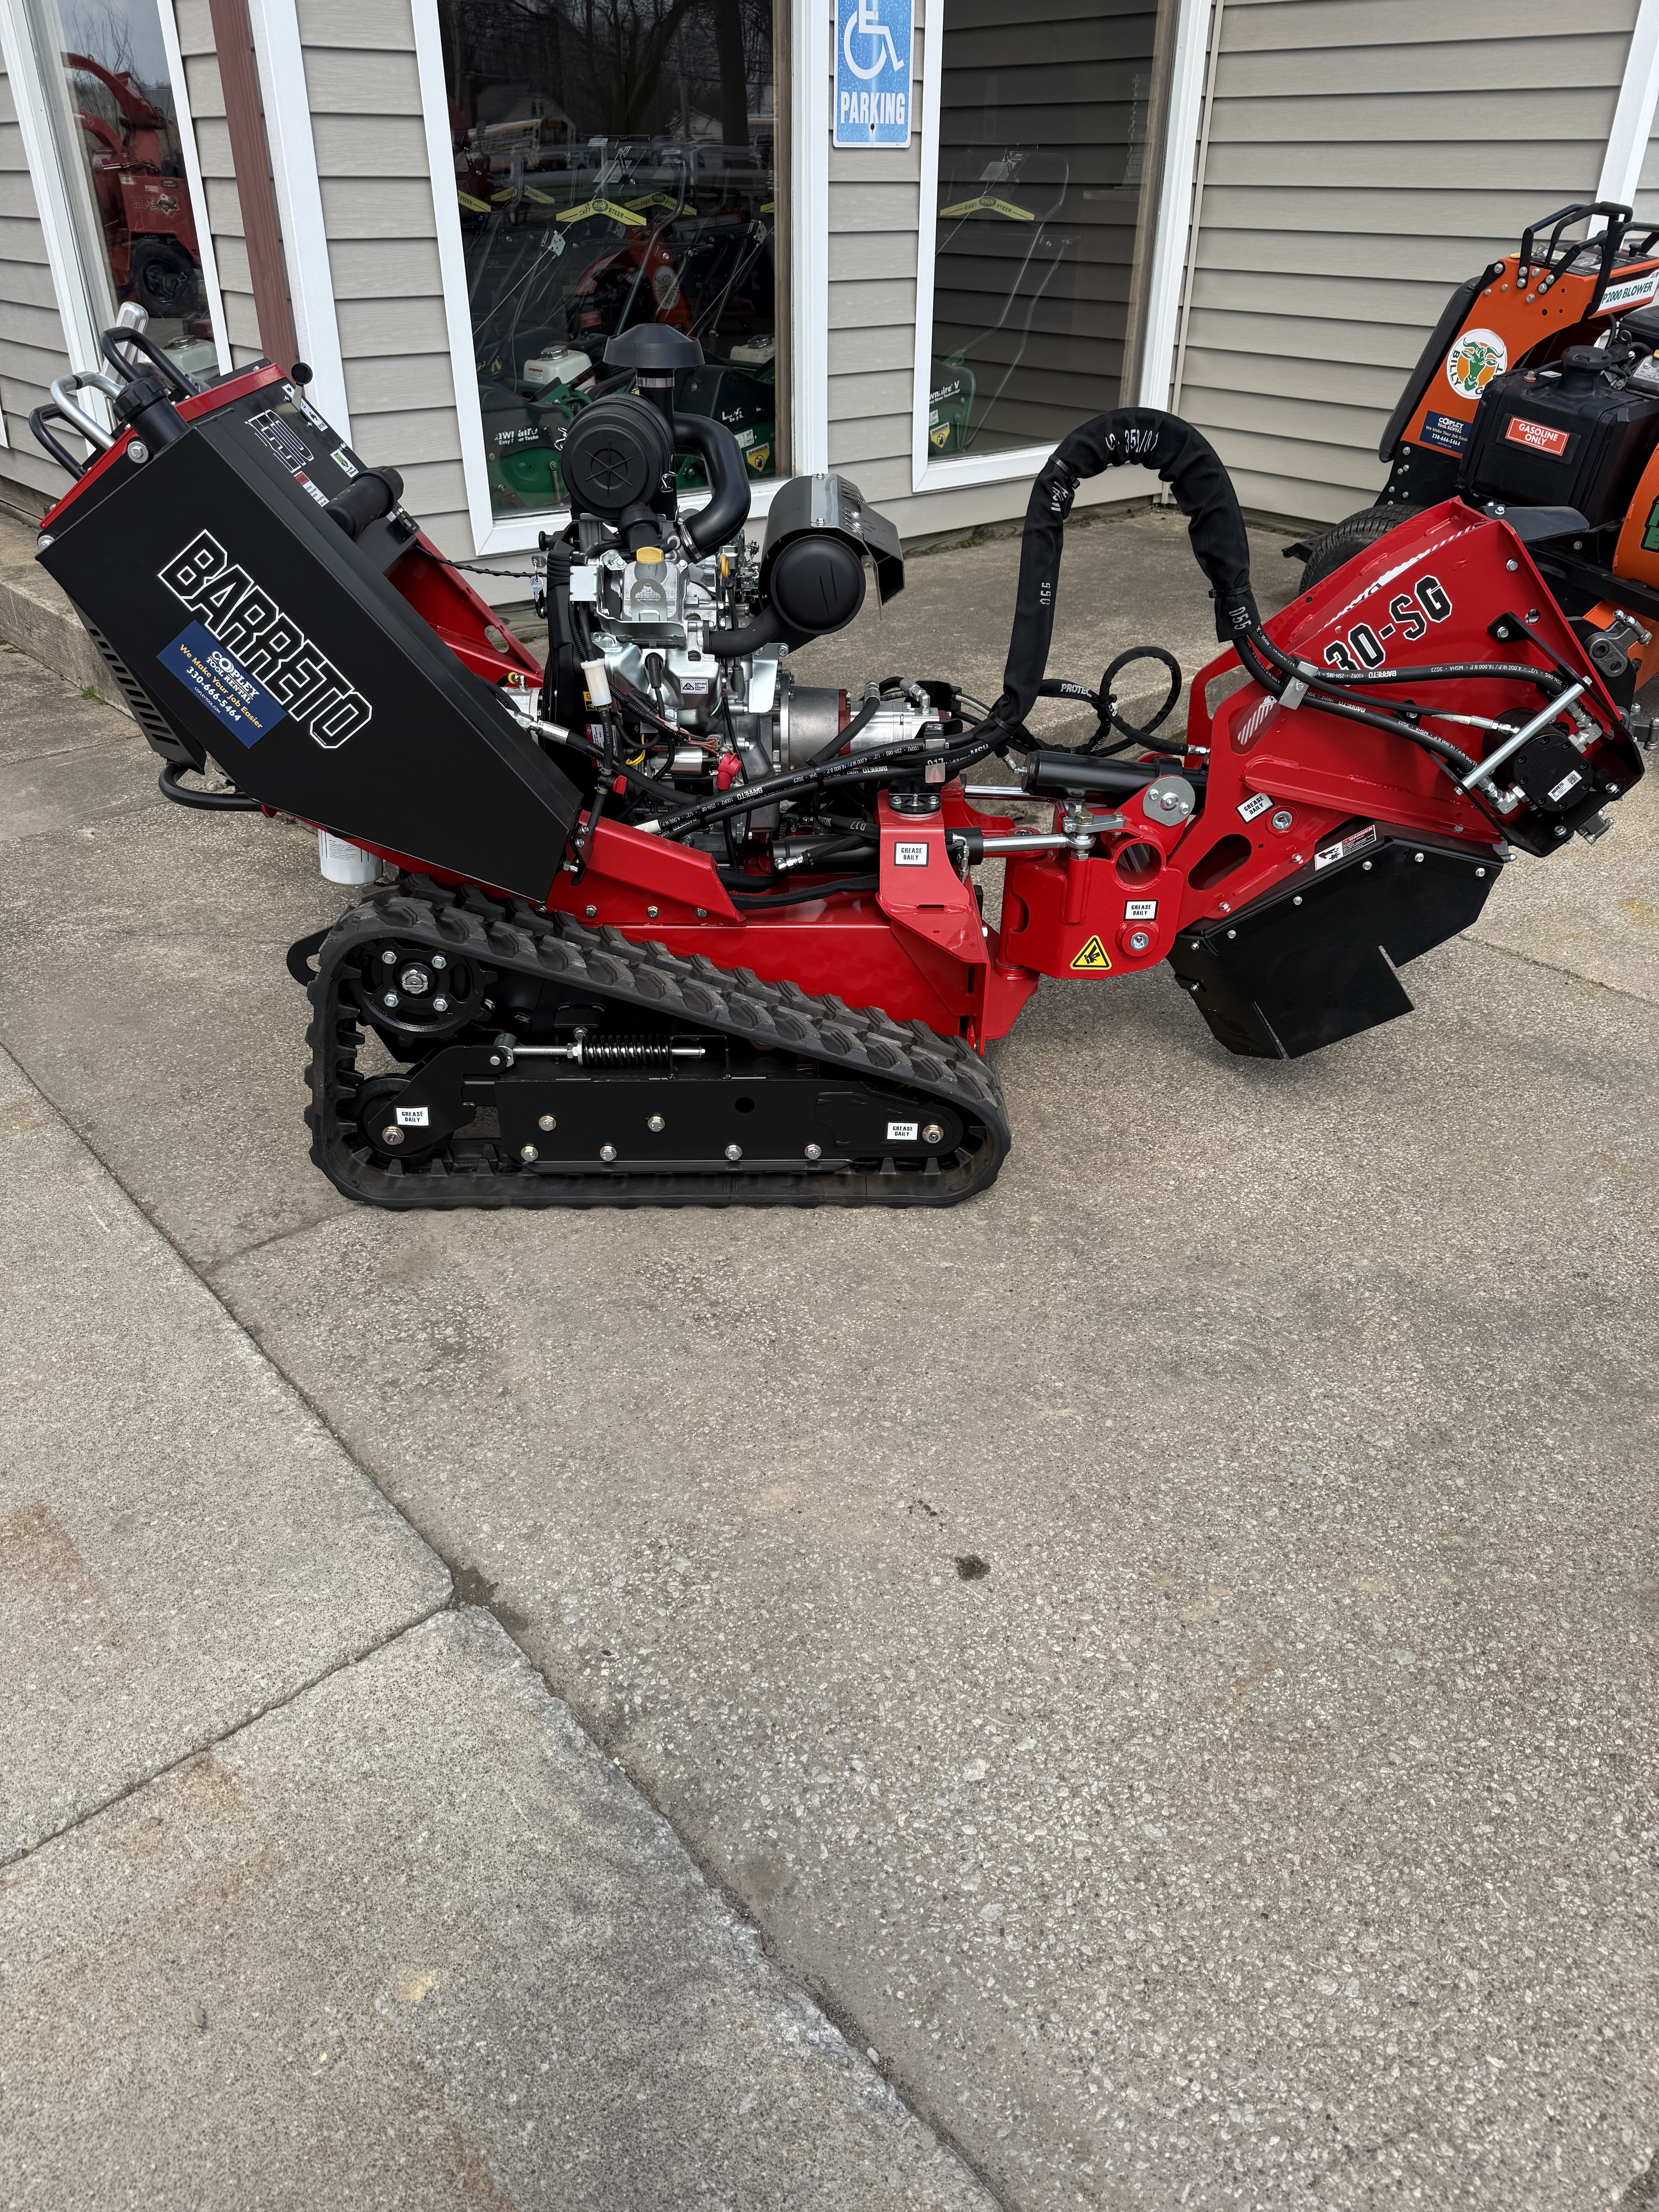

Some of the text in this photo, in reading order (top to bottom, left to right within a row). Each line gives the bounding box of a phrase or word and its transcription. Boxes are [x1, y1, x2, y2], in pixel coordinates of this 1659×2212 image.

[840, 91, 905, 125] PARKING
[608, 208, 624, 219] STEER
[996, 204, 1012, 213] STEER
[1622, 281, 1653, 299] BLOWER
[1450, 350, 1462, 385] BILLY
[954, 380, 960, 389] V
[931, 424, 948, 435] DANGER
[1439, 417, 1464, 429] COPLEY
[1518, 423, 1559, 441] GASOLINE
[1432, 433, 1461, 446] 330-666-5464
[1525, 434, 1547, 446] ONLY
[748, 445, 768, 456] DANGER
[1324, 574, 1453, 687] 30-SG
[158, 529, 372, 749] BARRETO
[206, 657, 251, 704] TOOL RENTAL
[212, 651, 260, 698] COPLEY
[1368, 670, 1397, 678] BARRETO
[180, 644, 263, 729] We Make Your Job Easier
[1060, 683, 1092, 698] PROTEC
[186, 666, 242, 721] 330-666-5464
[1338, 701, 1366, 713] BARRETO
[1415, 727, 1429, 736] MSHA
[886, 748, 903, 757] 2SN-08S
[737, 787, 763, 800] BARRETO
[1243, 795, 1264, 812] GREASE
[1249, 802, 1264, 815] DAILY
[669, 816, 680, 824] 4,000
[1349, 827, 1373, 841] DANGER
